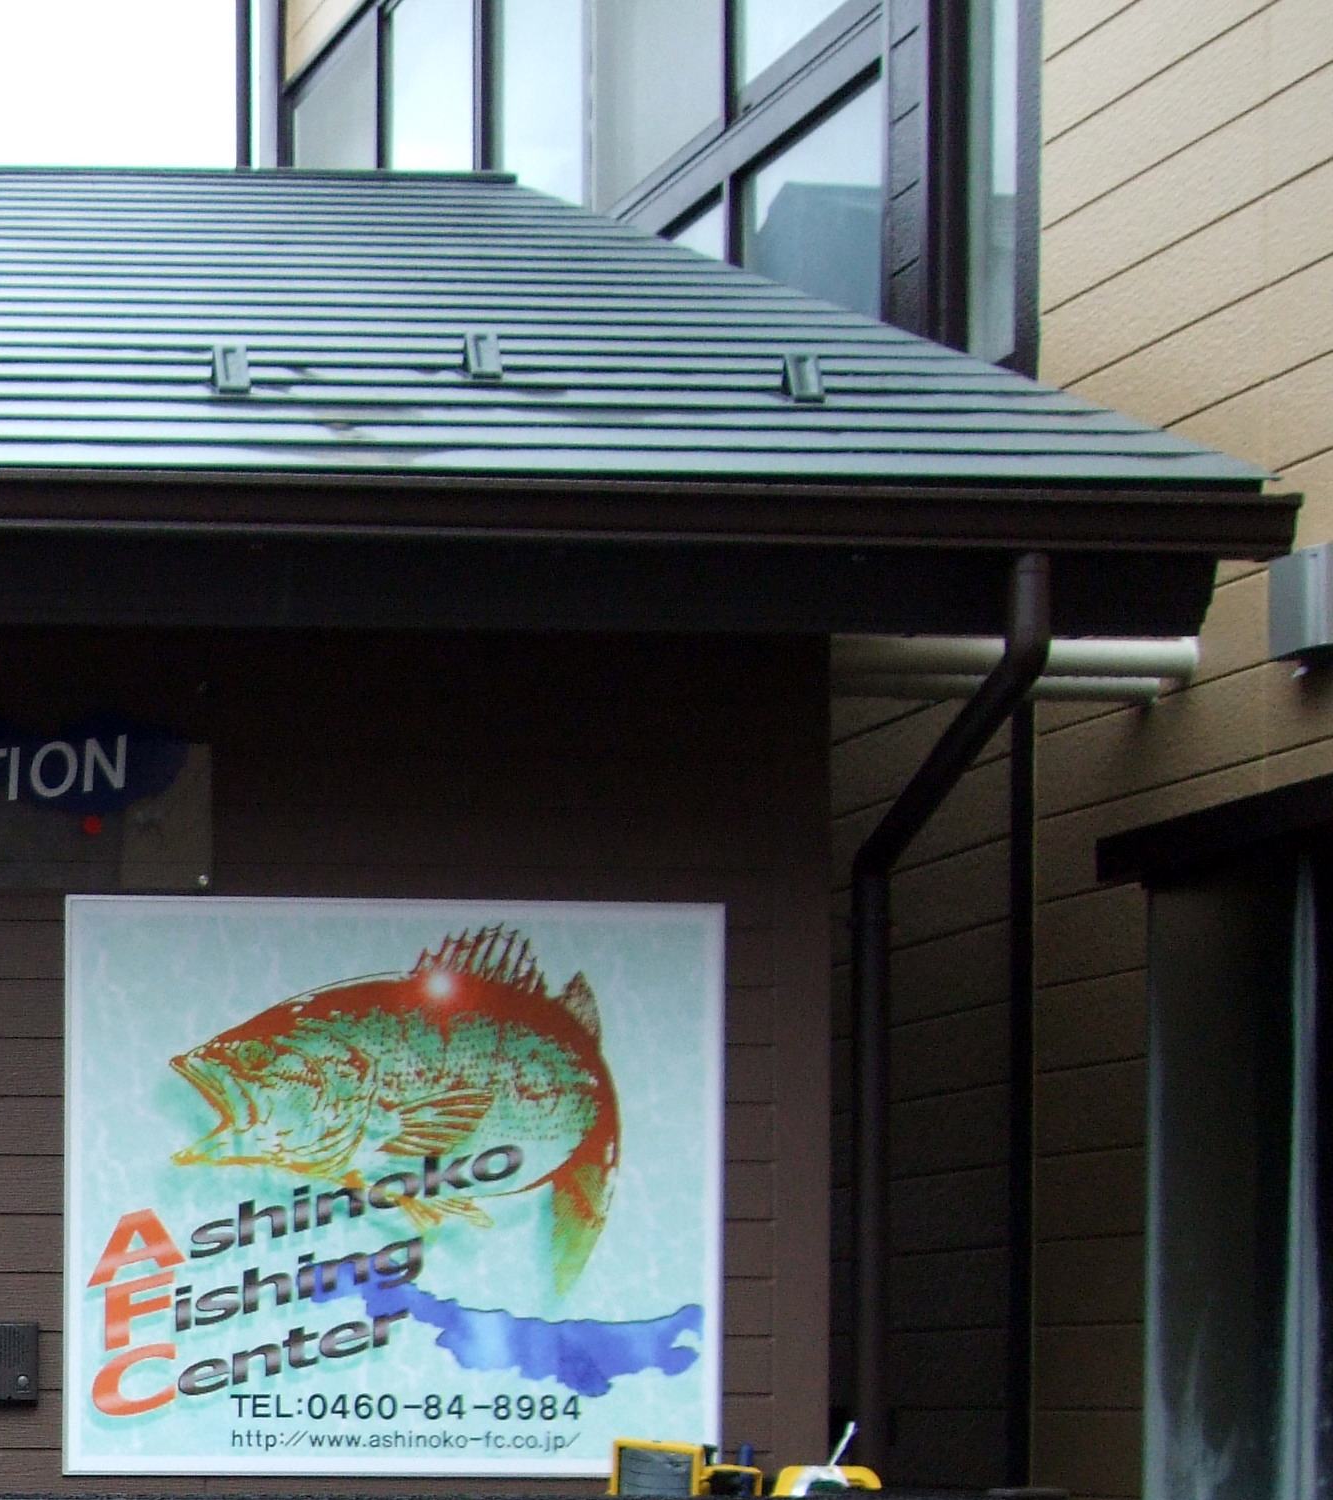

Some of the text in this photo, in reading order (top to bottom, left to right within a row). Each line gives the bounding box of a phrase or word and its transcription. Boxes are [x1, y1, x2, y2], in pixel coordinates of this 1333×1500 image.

[88, 1144, 525, 1287] Ashinoko
[102, 1235, 424, 1352] Fishing
[90, 1307, 409, 1417] Center
[232, 1394, 582, 1421] TEL:0460-84-8984
[231, 1429, 581, 1452] http://www.ashinoko-fc.co.jp/
